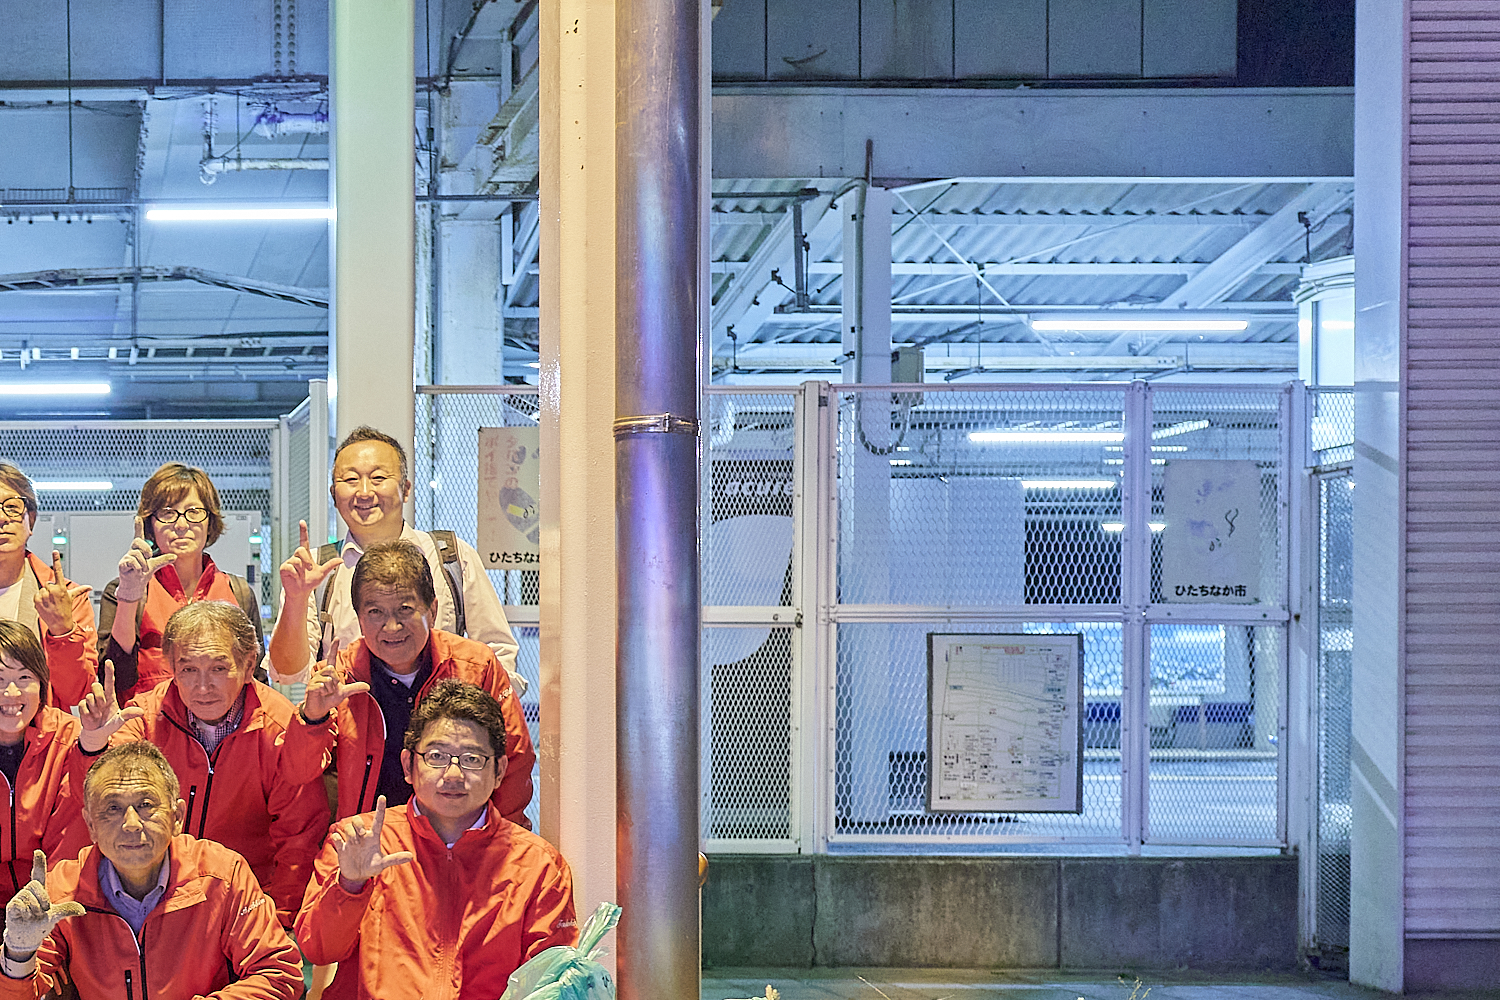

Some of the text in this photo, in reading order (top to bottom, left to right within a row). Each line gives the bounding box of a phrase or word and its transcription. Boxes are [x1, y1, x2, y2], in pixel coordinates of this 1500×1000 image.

[1174, 584, 1247, 598] ひたちなか市
